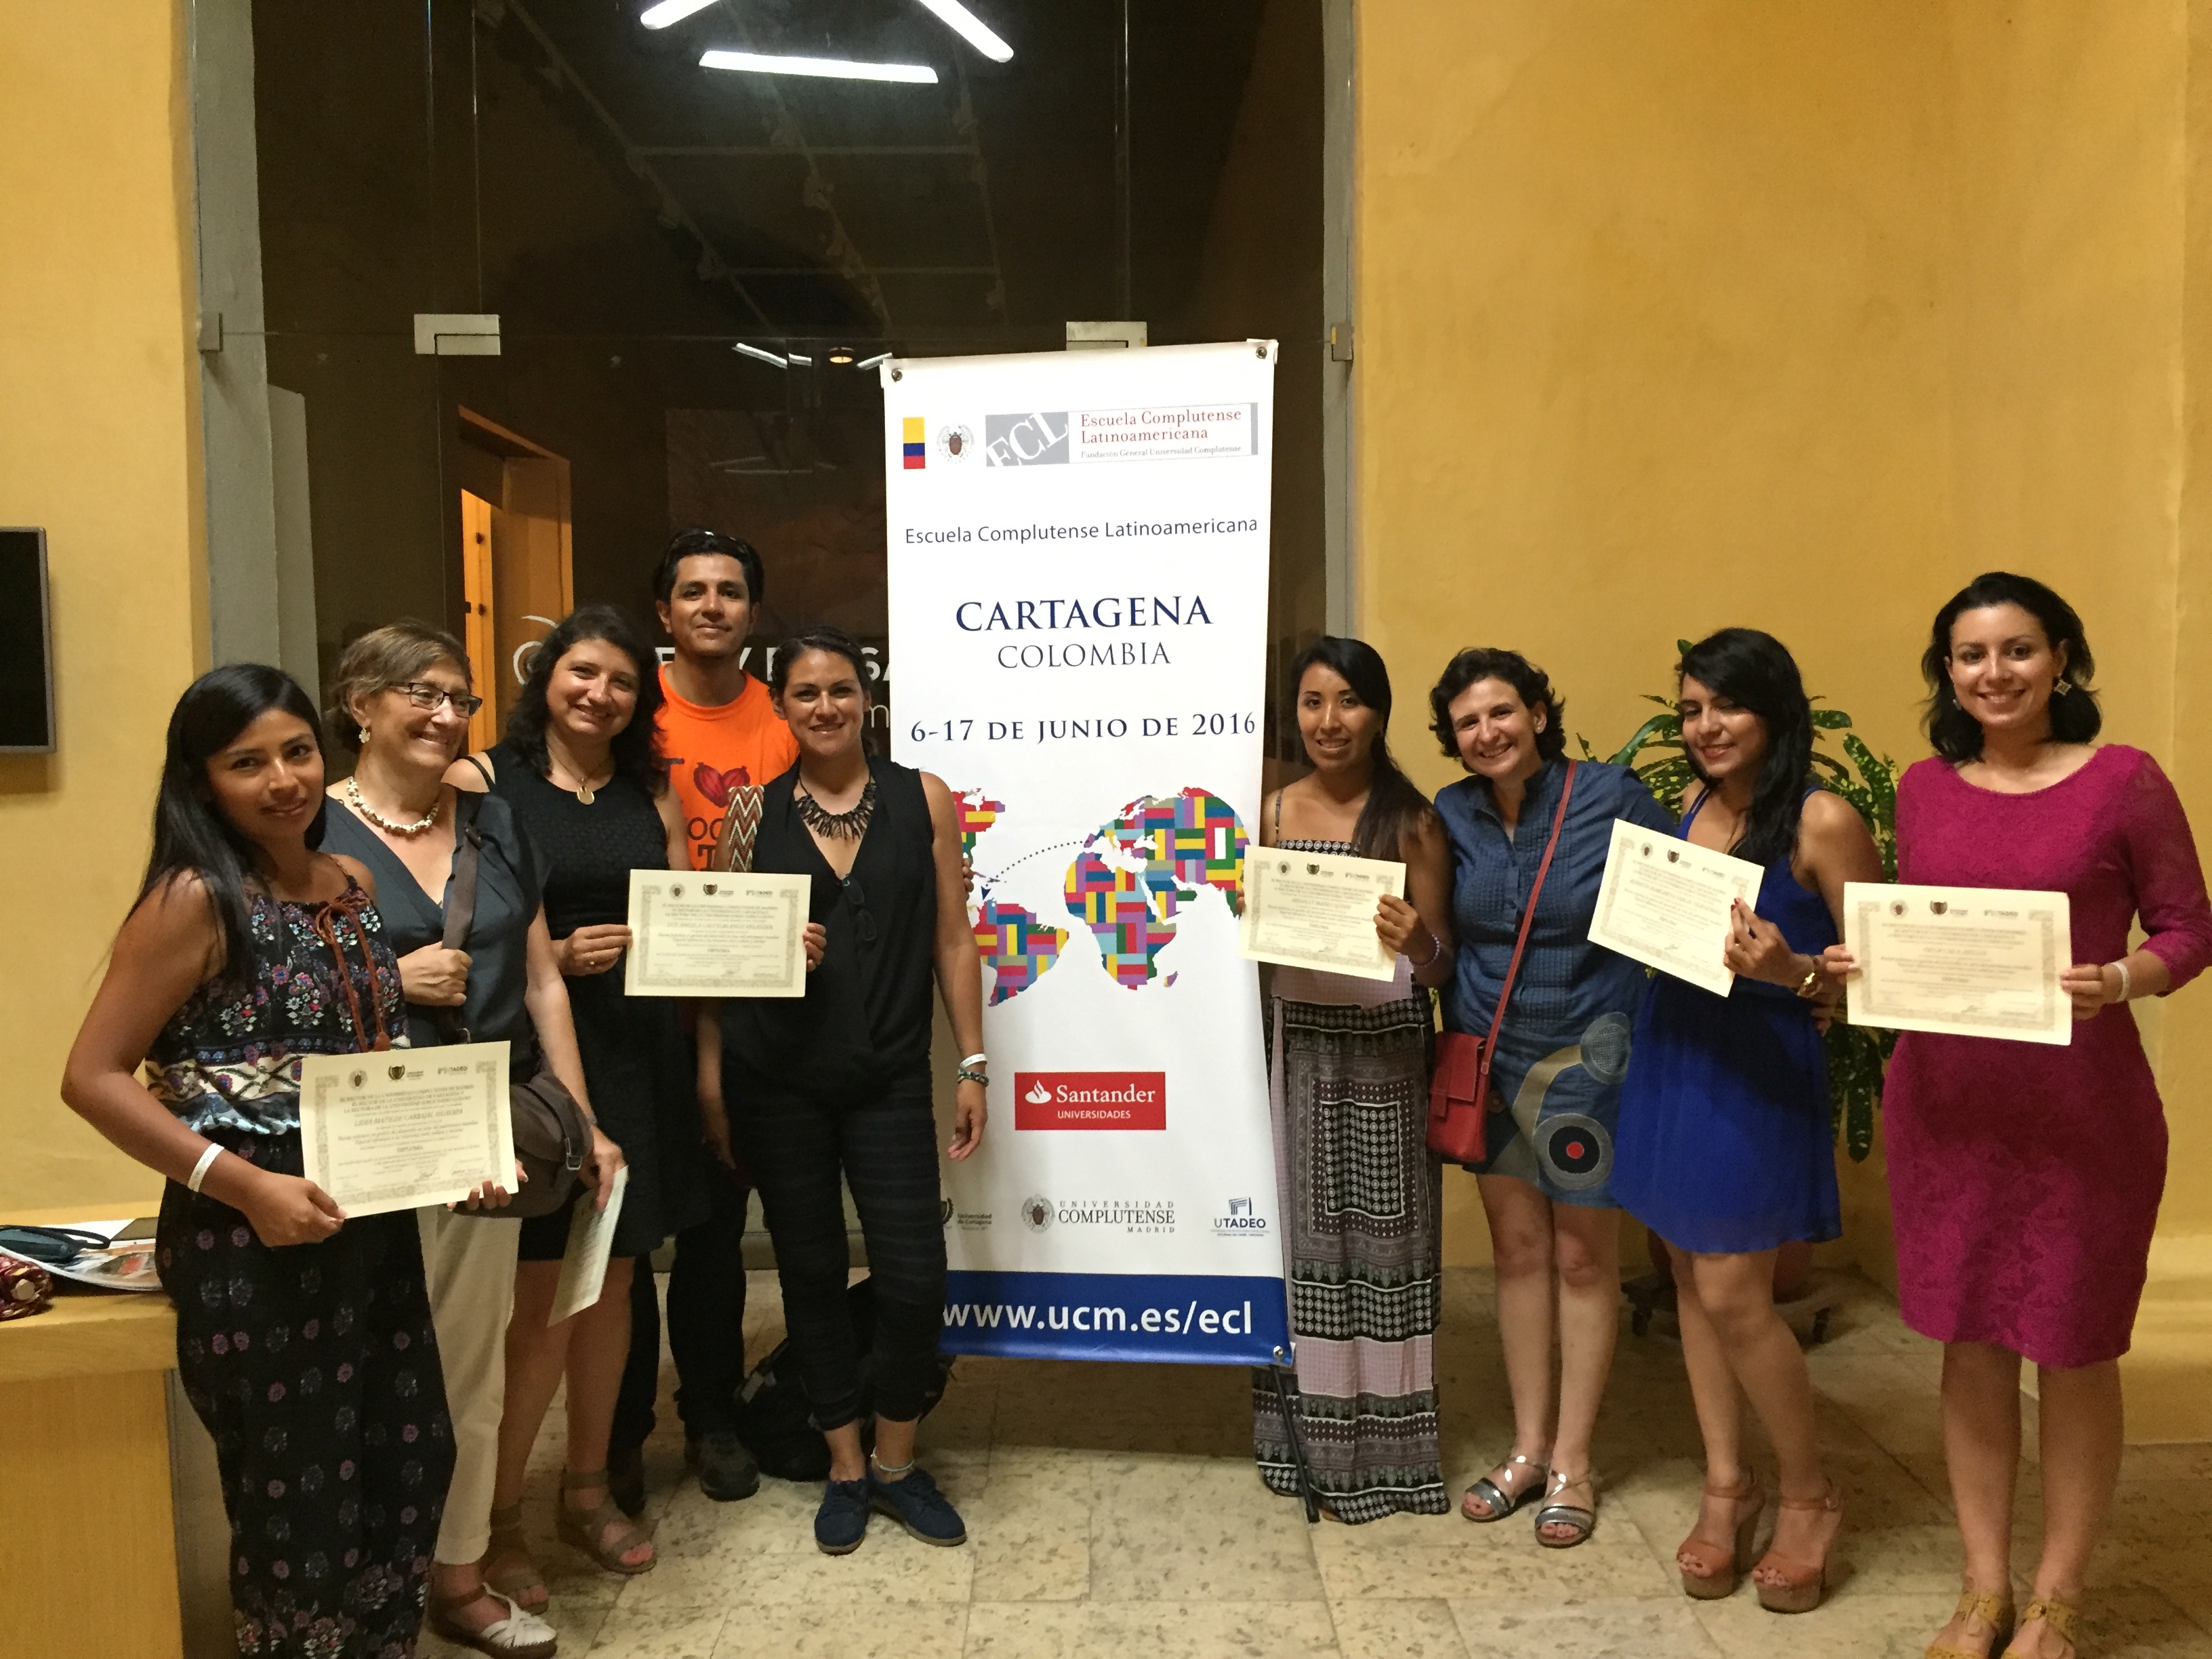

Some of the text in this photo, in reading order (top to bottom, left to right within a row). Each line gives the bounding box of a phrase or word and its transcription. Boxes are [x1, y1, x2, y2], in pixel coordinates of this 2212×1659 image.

[1081, 409, 1242, 428] Escuela Complutense
[987, 412, 1069, 466] ECL
[1081, 428, 1208, 444] Latinoamericana
[1081, 445, 1242, 459] Fundación General Universidad Complutense
[905, 518, 1258, 544] Escuela Complutense Latinoamericana
[956, 594, 1214, 632] CARTAGENA
[998, 642, 1171, 669] COLOMBIA
[911, 712, 1255, 744] 6-17 DE JUNIO DE 2016
[1056, 1084, 1156, 1104] Santander
[1057, 1109, 1131, 1120] UNIVERSIDADES
[1059, 1200, 1174, 1208] UNIVERSIDAD
[1059, 1209, 1175, 1225] COMPLUTENSE
[1214, 1218, 1267, 1229] UTADEO
[943, 1300, 1252, 1335] www.ucm.es/ecl
